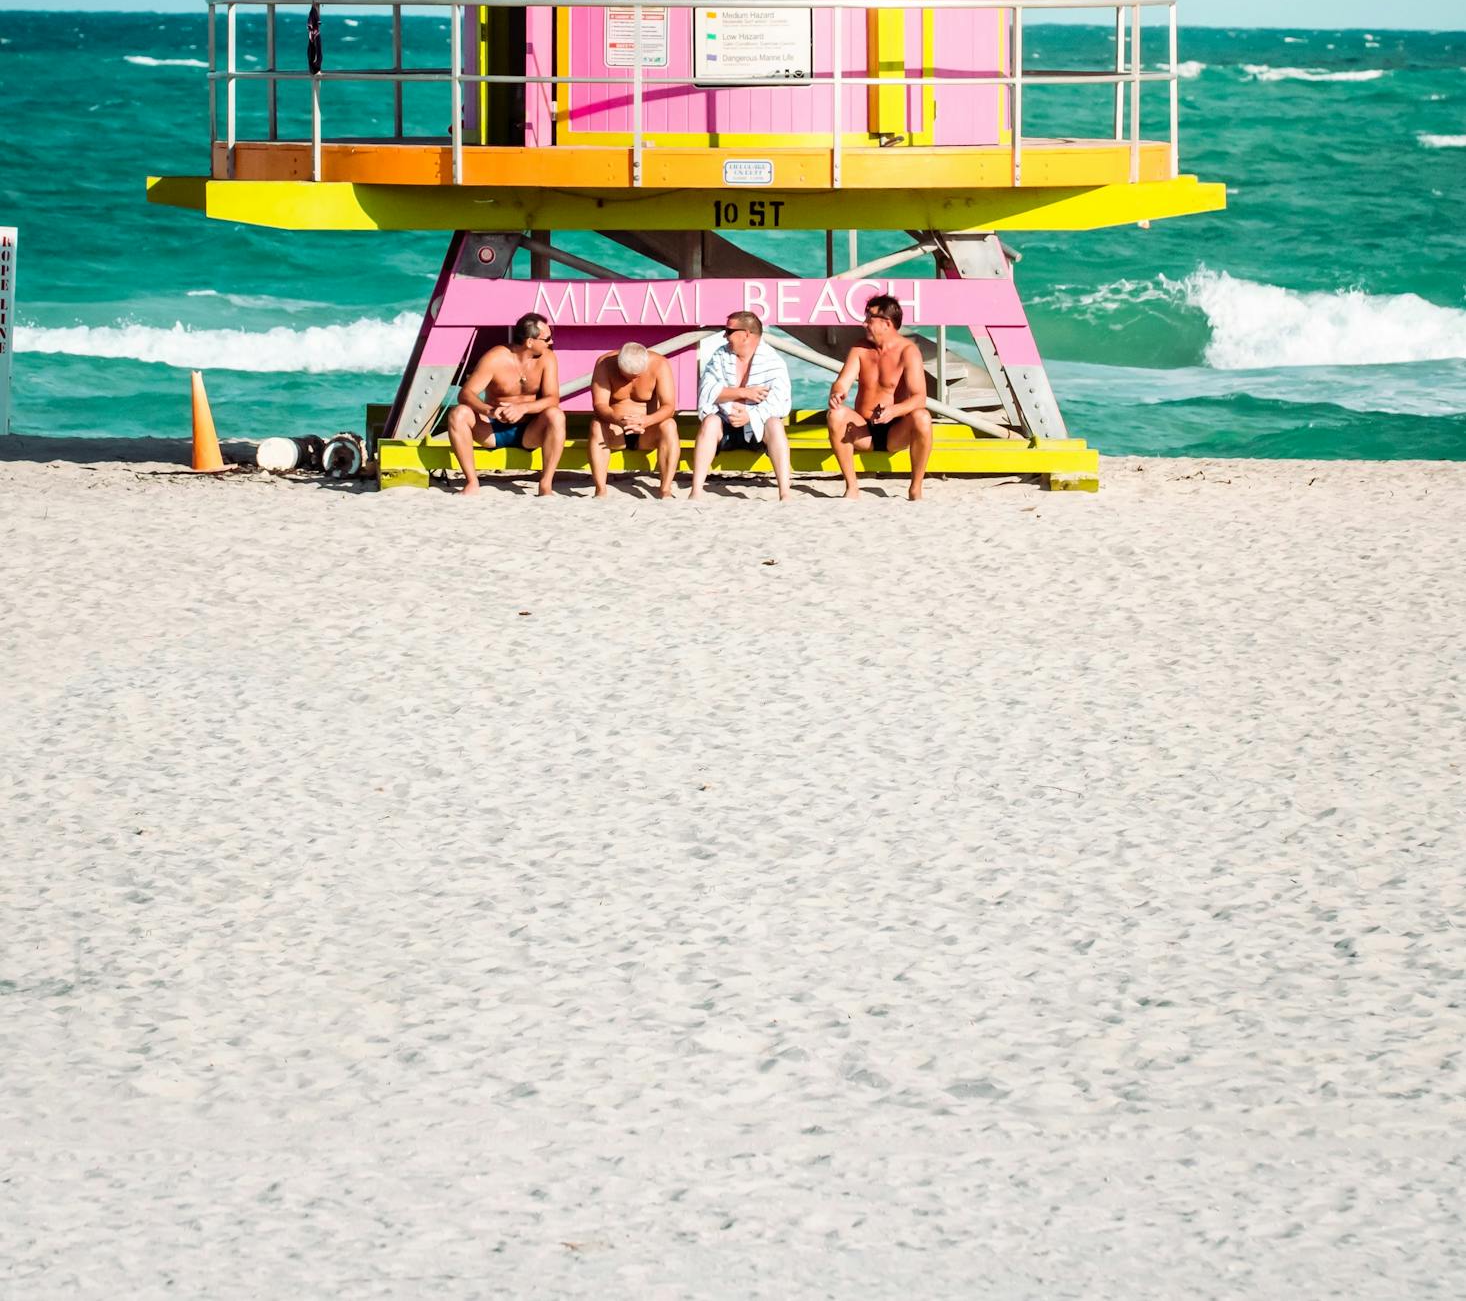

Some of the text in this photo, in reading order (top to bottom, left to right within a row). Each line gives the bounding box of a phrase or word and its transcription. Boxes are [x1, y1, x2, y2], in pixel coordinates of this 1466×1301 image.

[722, 54, 757, 62] Dangerous
[714, 200, 785, 227] 10 ST
[0, 236, 11, 353] ROPE LINE
[533, 280, 921, 324] MIAMI BEACH
